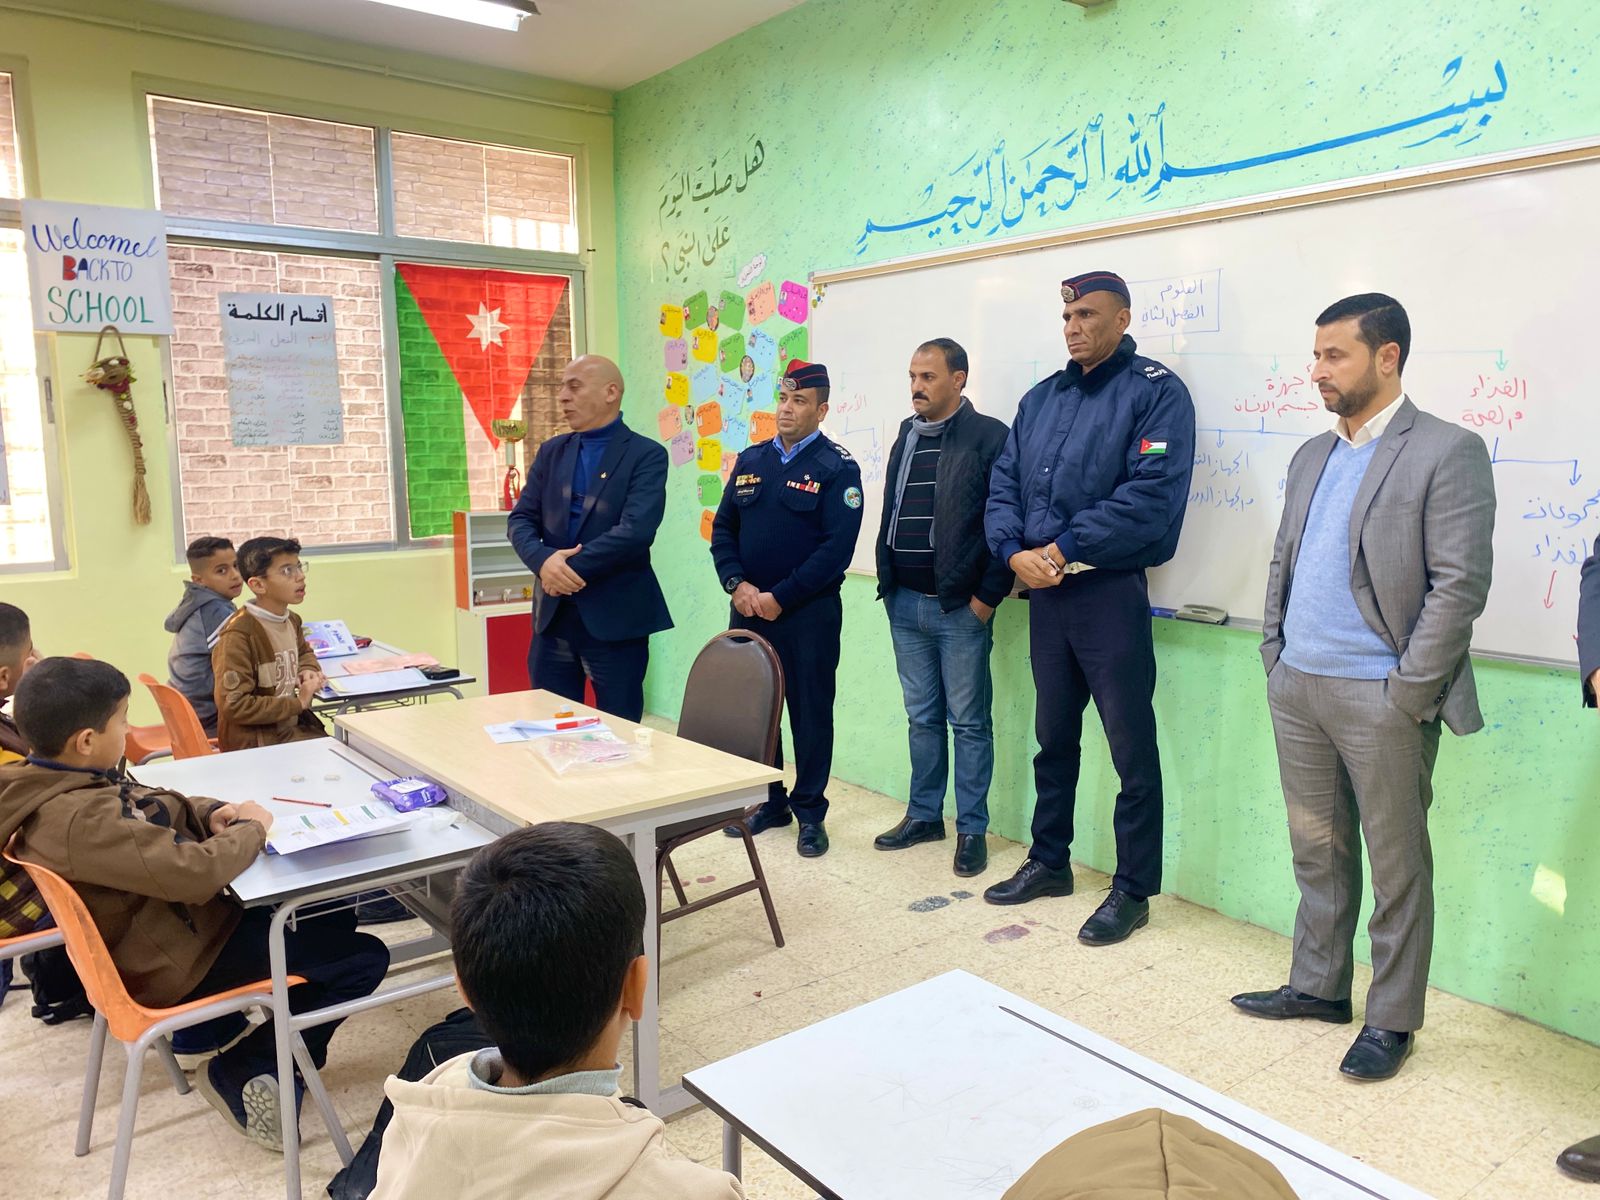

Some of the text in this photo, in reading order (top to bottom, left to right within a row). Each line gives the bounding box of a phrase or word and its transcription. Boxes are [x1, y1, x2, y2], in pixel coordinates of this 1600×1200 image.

[1160, 278, 1204, 302] العلوم
[47, 286, 154, 324] SCHOOL
[227, 302, 284, 321] الكلمة
